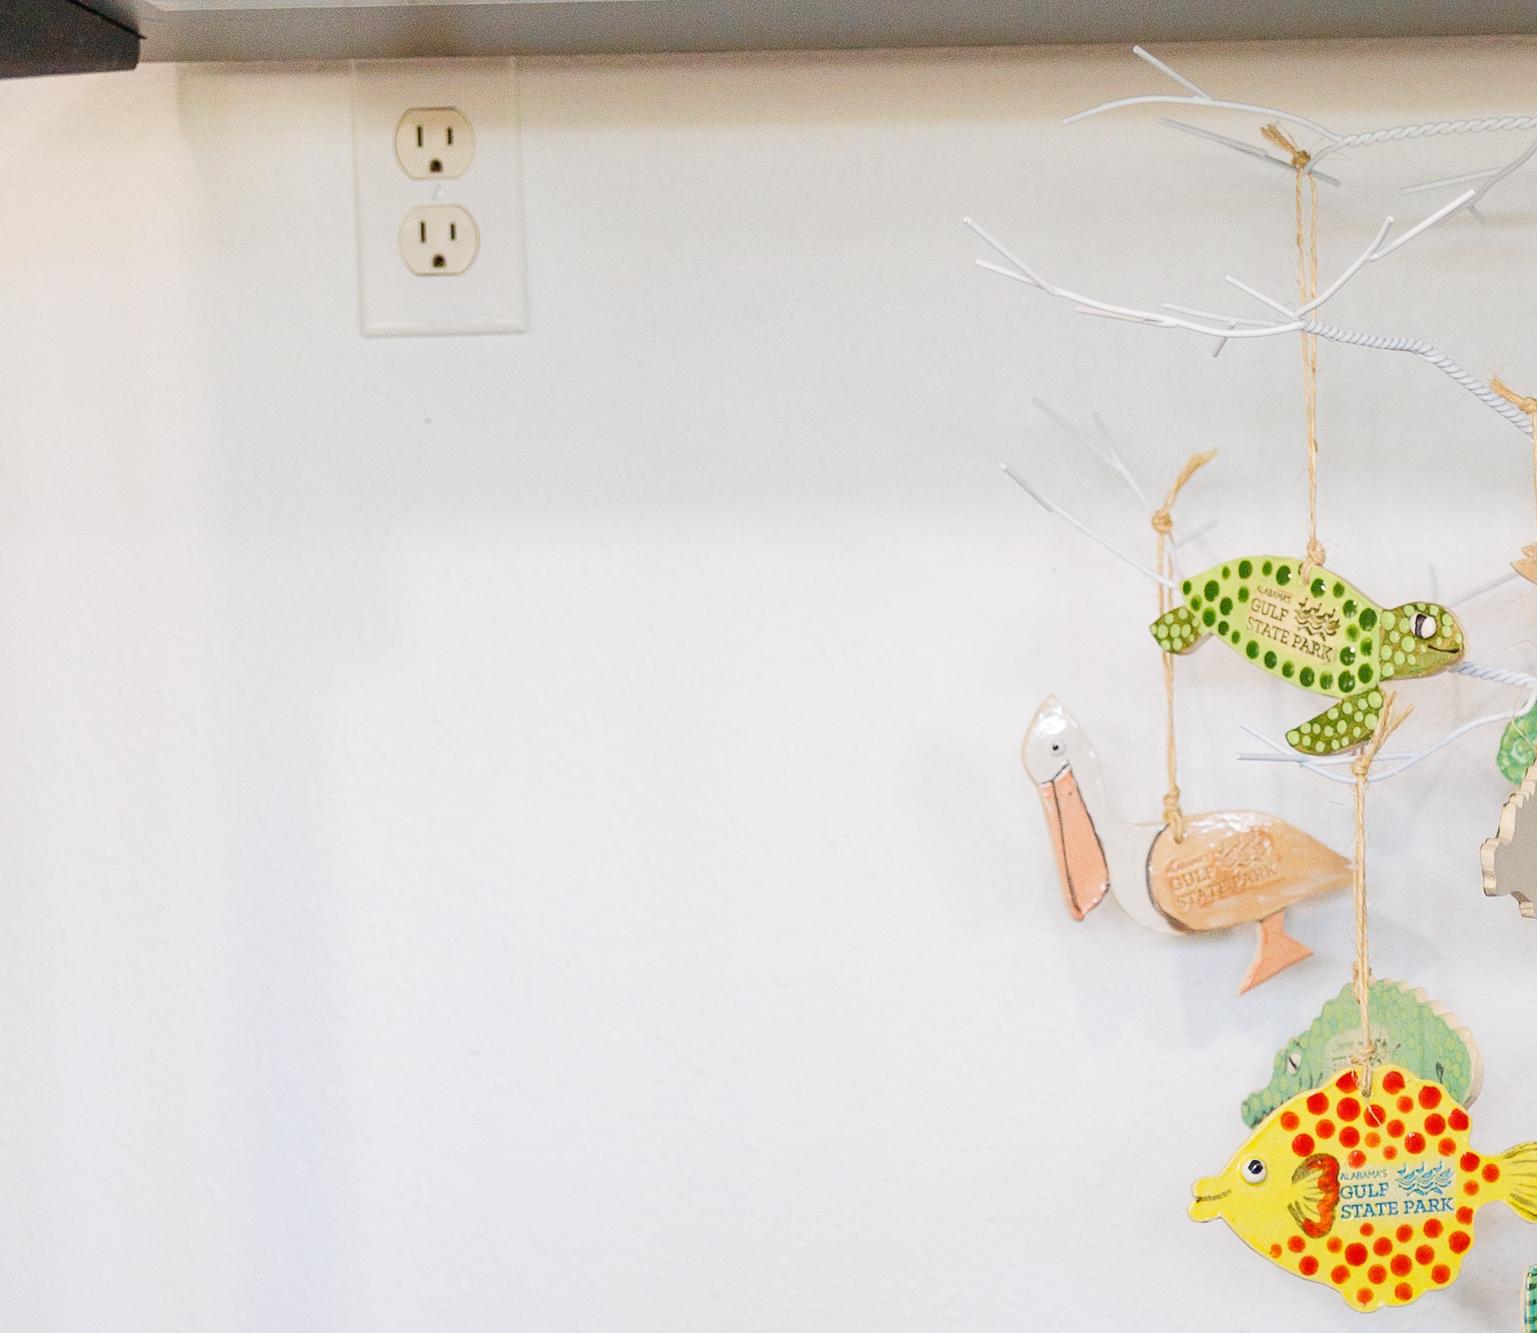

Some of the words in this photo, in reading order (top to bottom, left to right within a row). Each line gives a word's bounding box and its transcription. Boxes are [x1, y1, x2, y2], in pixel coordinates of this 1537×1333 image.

[1251, 598, 1289, 621] GULF
[1247, 616, 1290, 645] STATE
[1292, 634, 1333, 662] PARK
[1340, 1182, 1389, 1199] GULF
[1341, 1201, 1399, 1219] STATE
[1403, 1197, 1454, 1214] PARK
